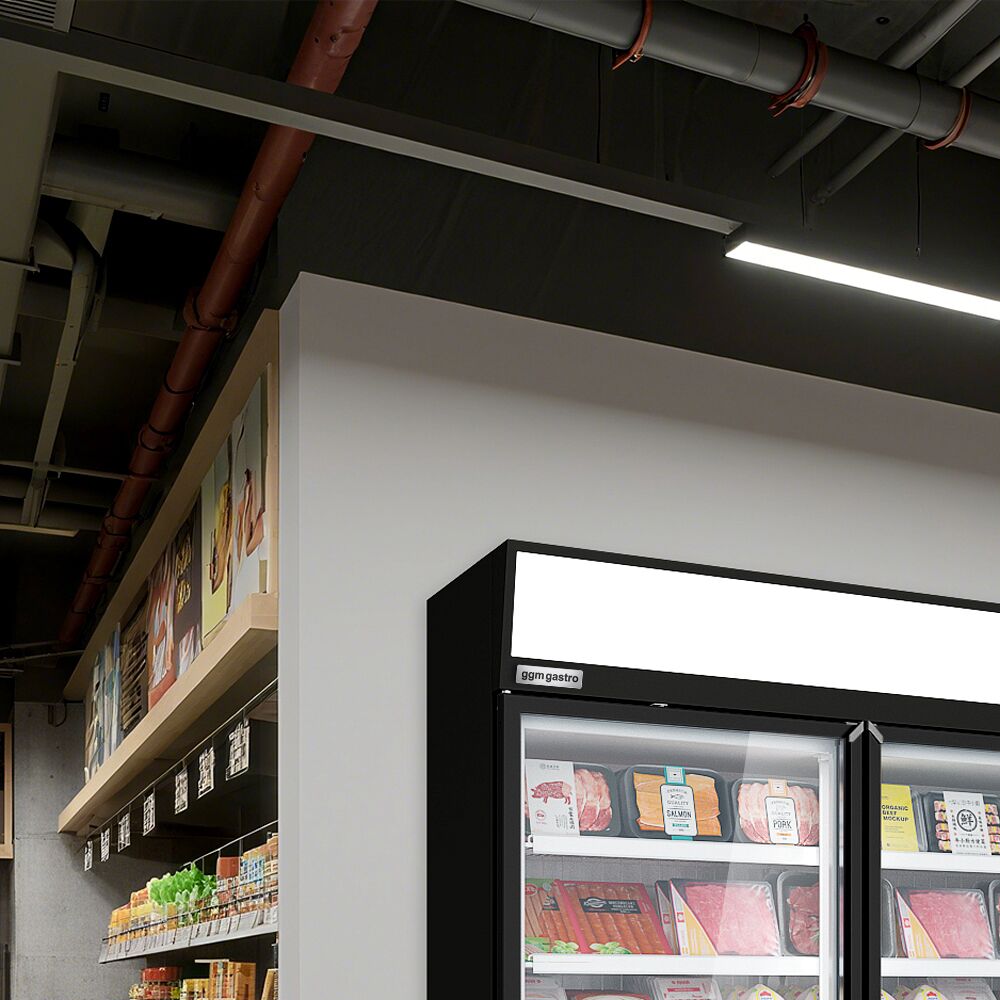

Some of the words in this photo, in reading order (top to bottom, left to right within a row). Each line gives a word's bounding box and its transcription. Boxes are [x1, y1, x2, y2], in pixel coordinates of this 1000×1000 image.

[522, 671, 544, 681] ggm
[546, 673, 578, 683] gastro
[666, 809, 692, 818] SALMON
[773, 820, 792, 829] PORK
